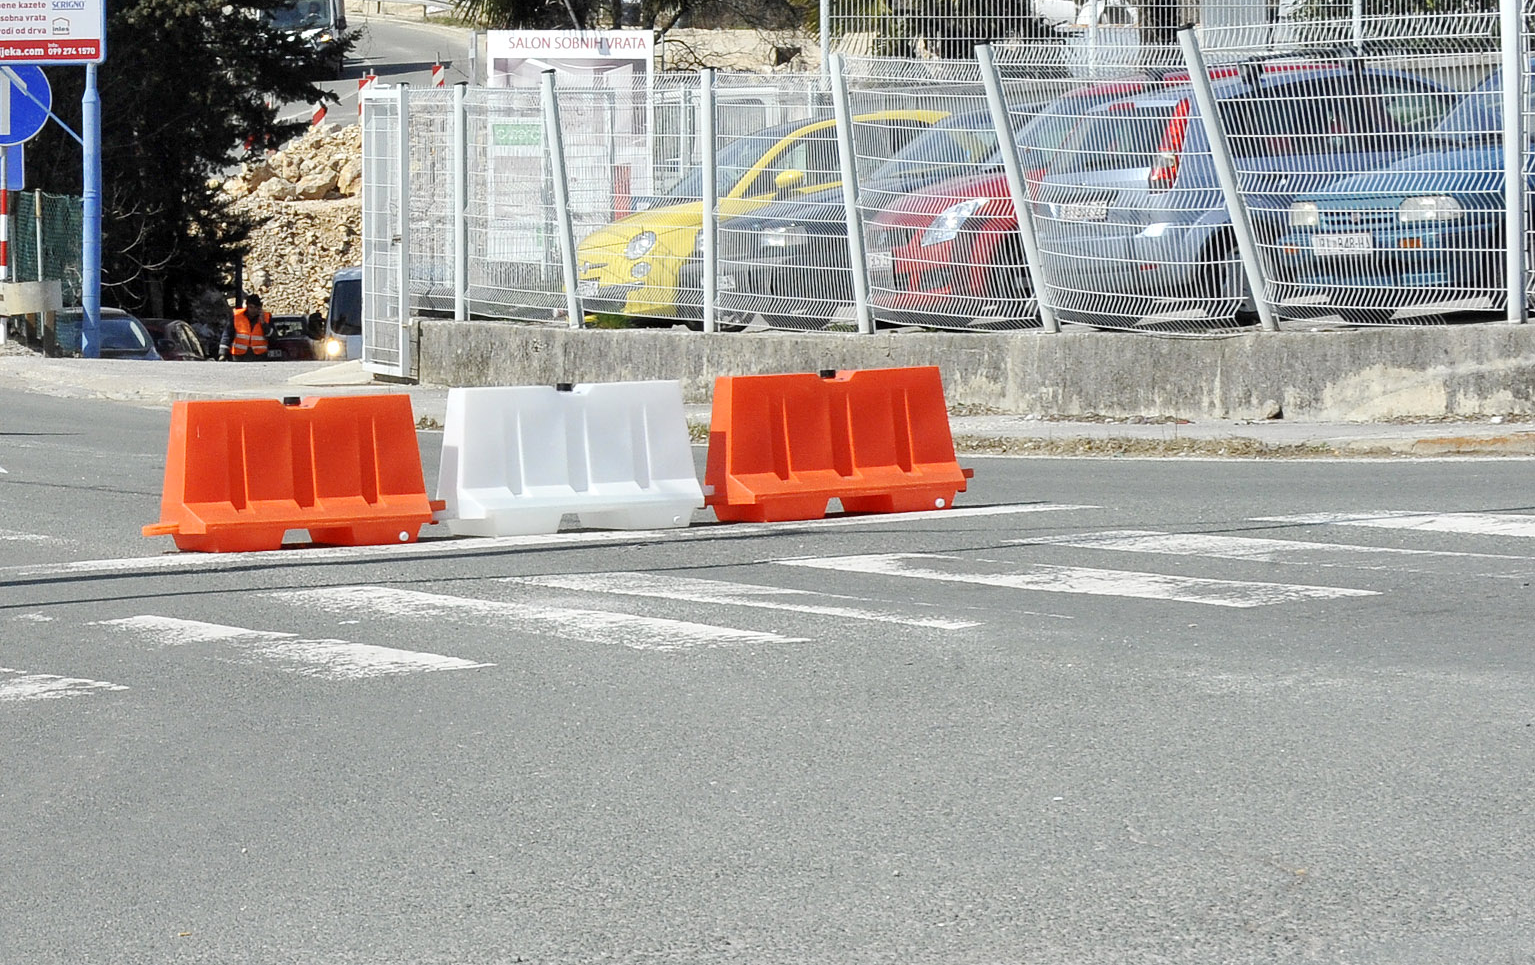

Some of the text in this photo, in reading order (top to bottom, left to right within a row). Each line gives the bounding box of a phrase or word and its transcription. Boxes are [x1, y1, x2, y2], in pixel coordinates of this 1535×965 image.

[508, 37, 646, 49] SALON SOBNIH VRATA
